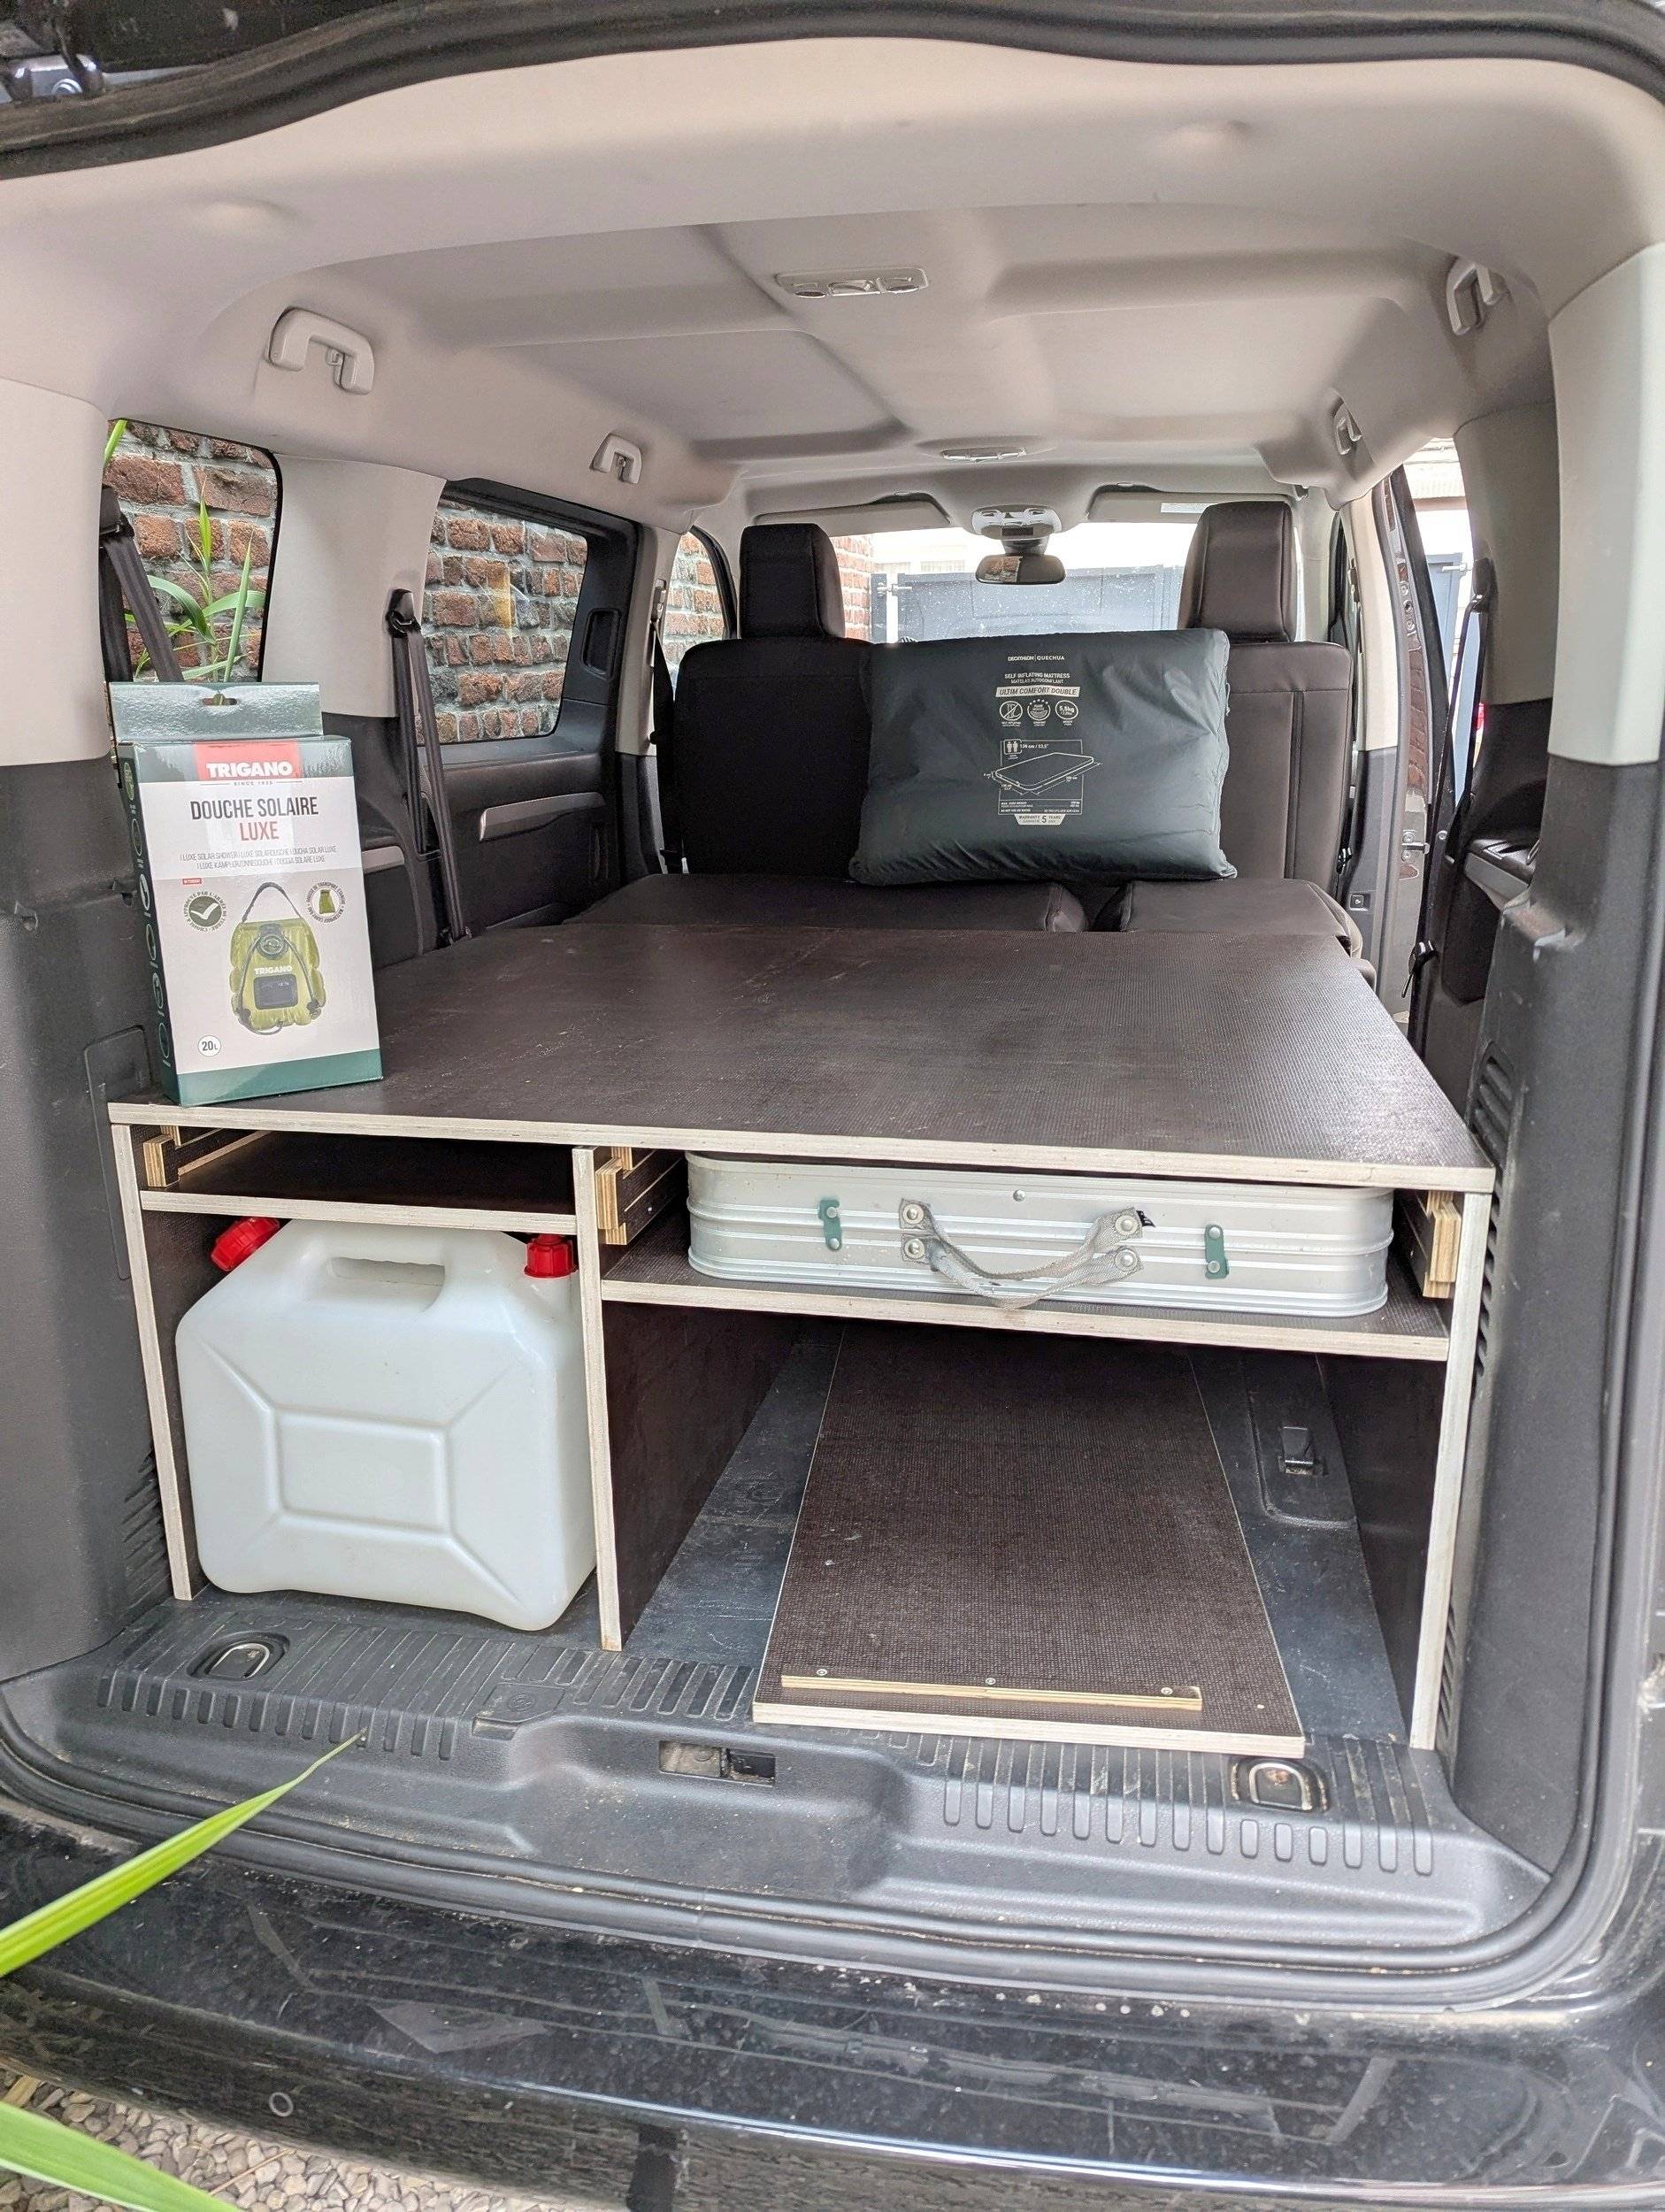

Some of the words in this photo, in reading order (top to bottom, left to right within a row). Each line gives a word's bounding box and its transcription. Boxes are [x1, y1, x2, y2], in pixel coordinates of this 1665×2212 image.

[206, 762, 294, 779] TRIGANO
[190, 799, 254, 820] DOUCHE
[257, 796, 319, 818] SOLAIRE
[1042, 815, 1047, 824] 5
[239, 821, 280, 841] LUXE
[182, 853, 196, 862] LUXE
[197, 852, 216, 861] SOLAR
[216, 851, 238, 860] SHOWER
[326, 845, 338, 854] LUXE
[254, 965, 293, 975] TRIGANO
